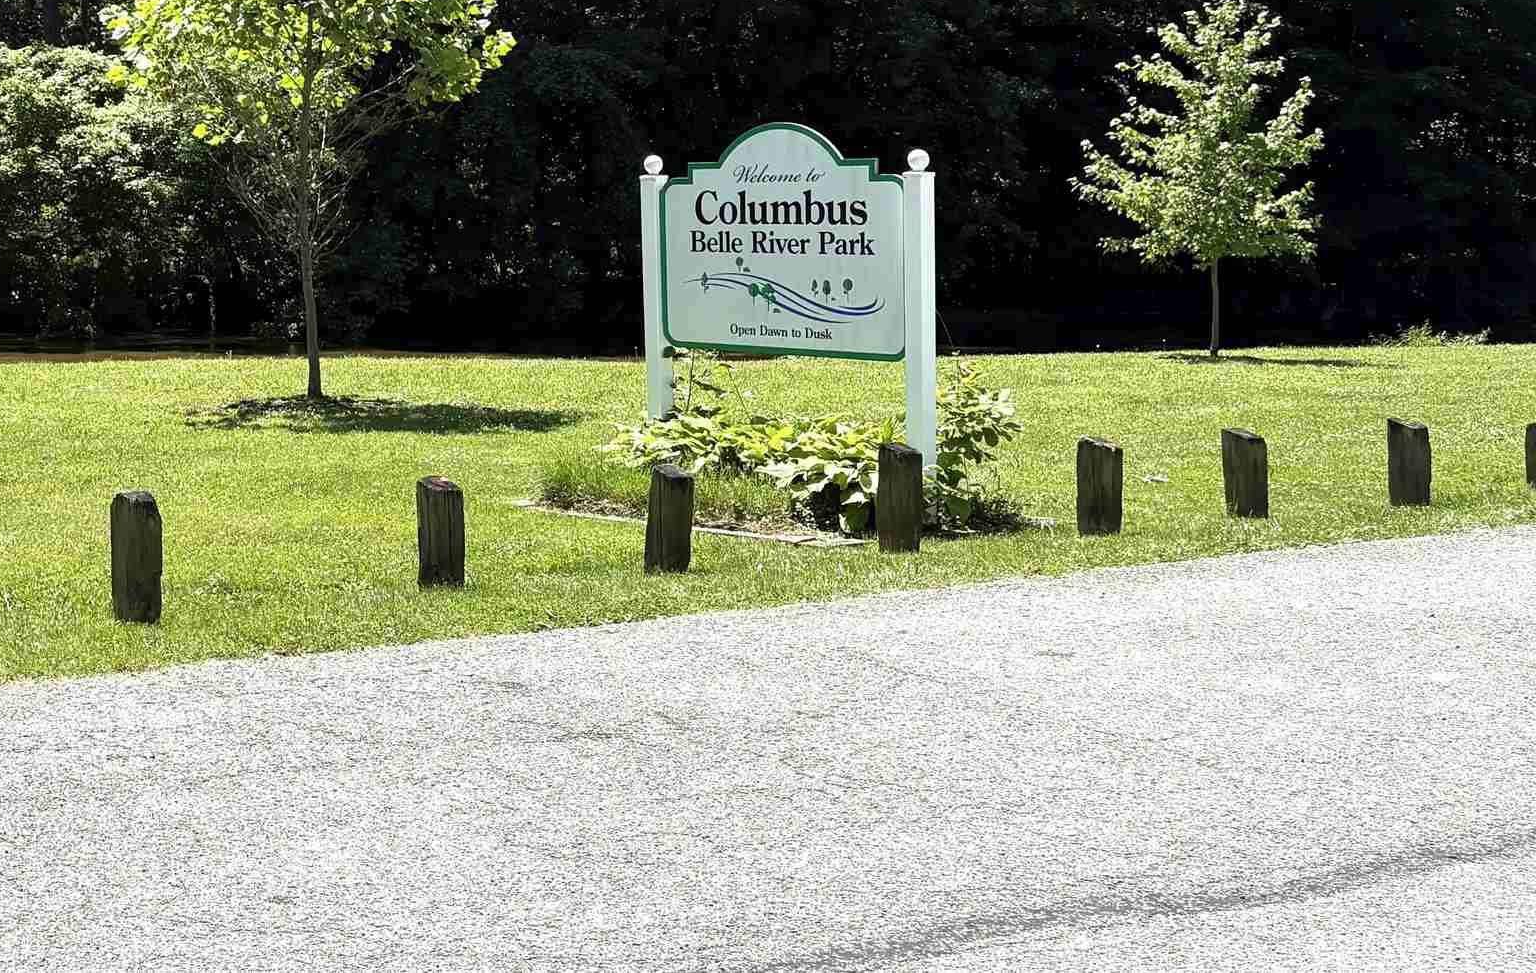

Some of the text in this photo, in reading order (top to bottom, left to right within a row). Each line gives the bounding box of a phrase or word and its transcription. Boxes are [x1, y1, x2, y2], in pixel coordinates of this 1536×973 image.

[733, 163, 825, 184] Welcome to
[695, 190, 868, 225] Columbus
[689, 230, 875, 256] Belle River Park
[730, 323, 833, 340] Open Dawn to Dusk
